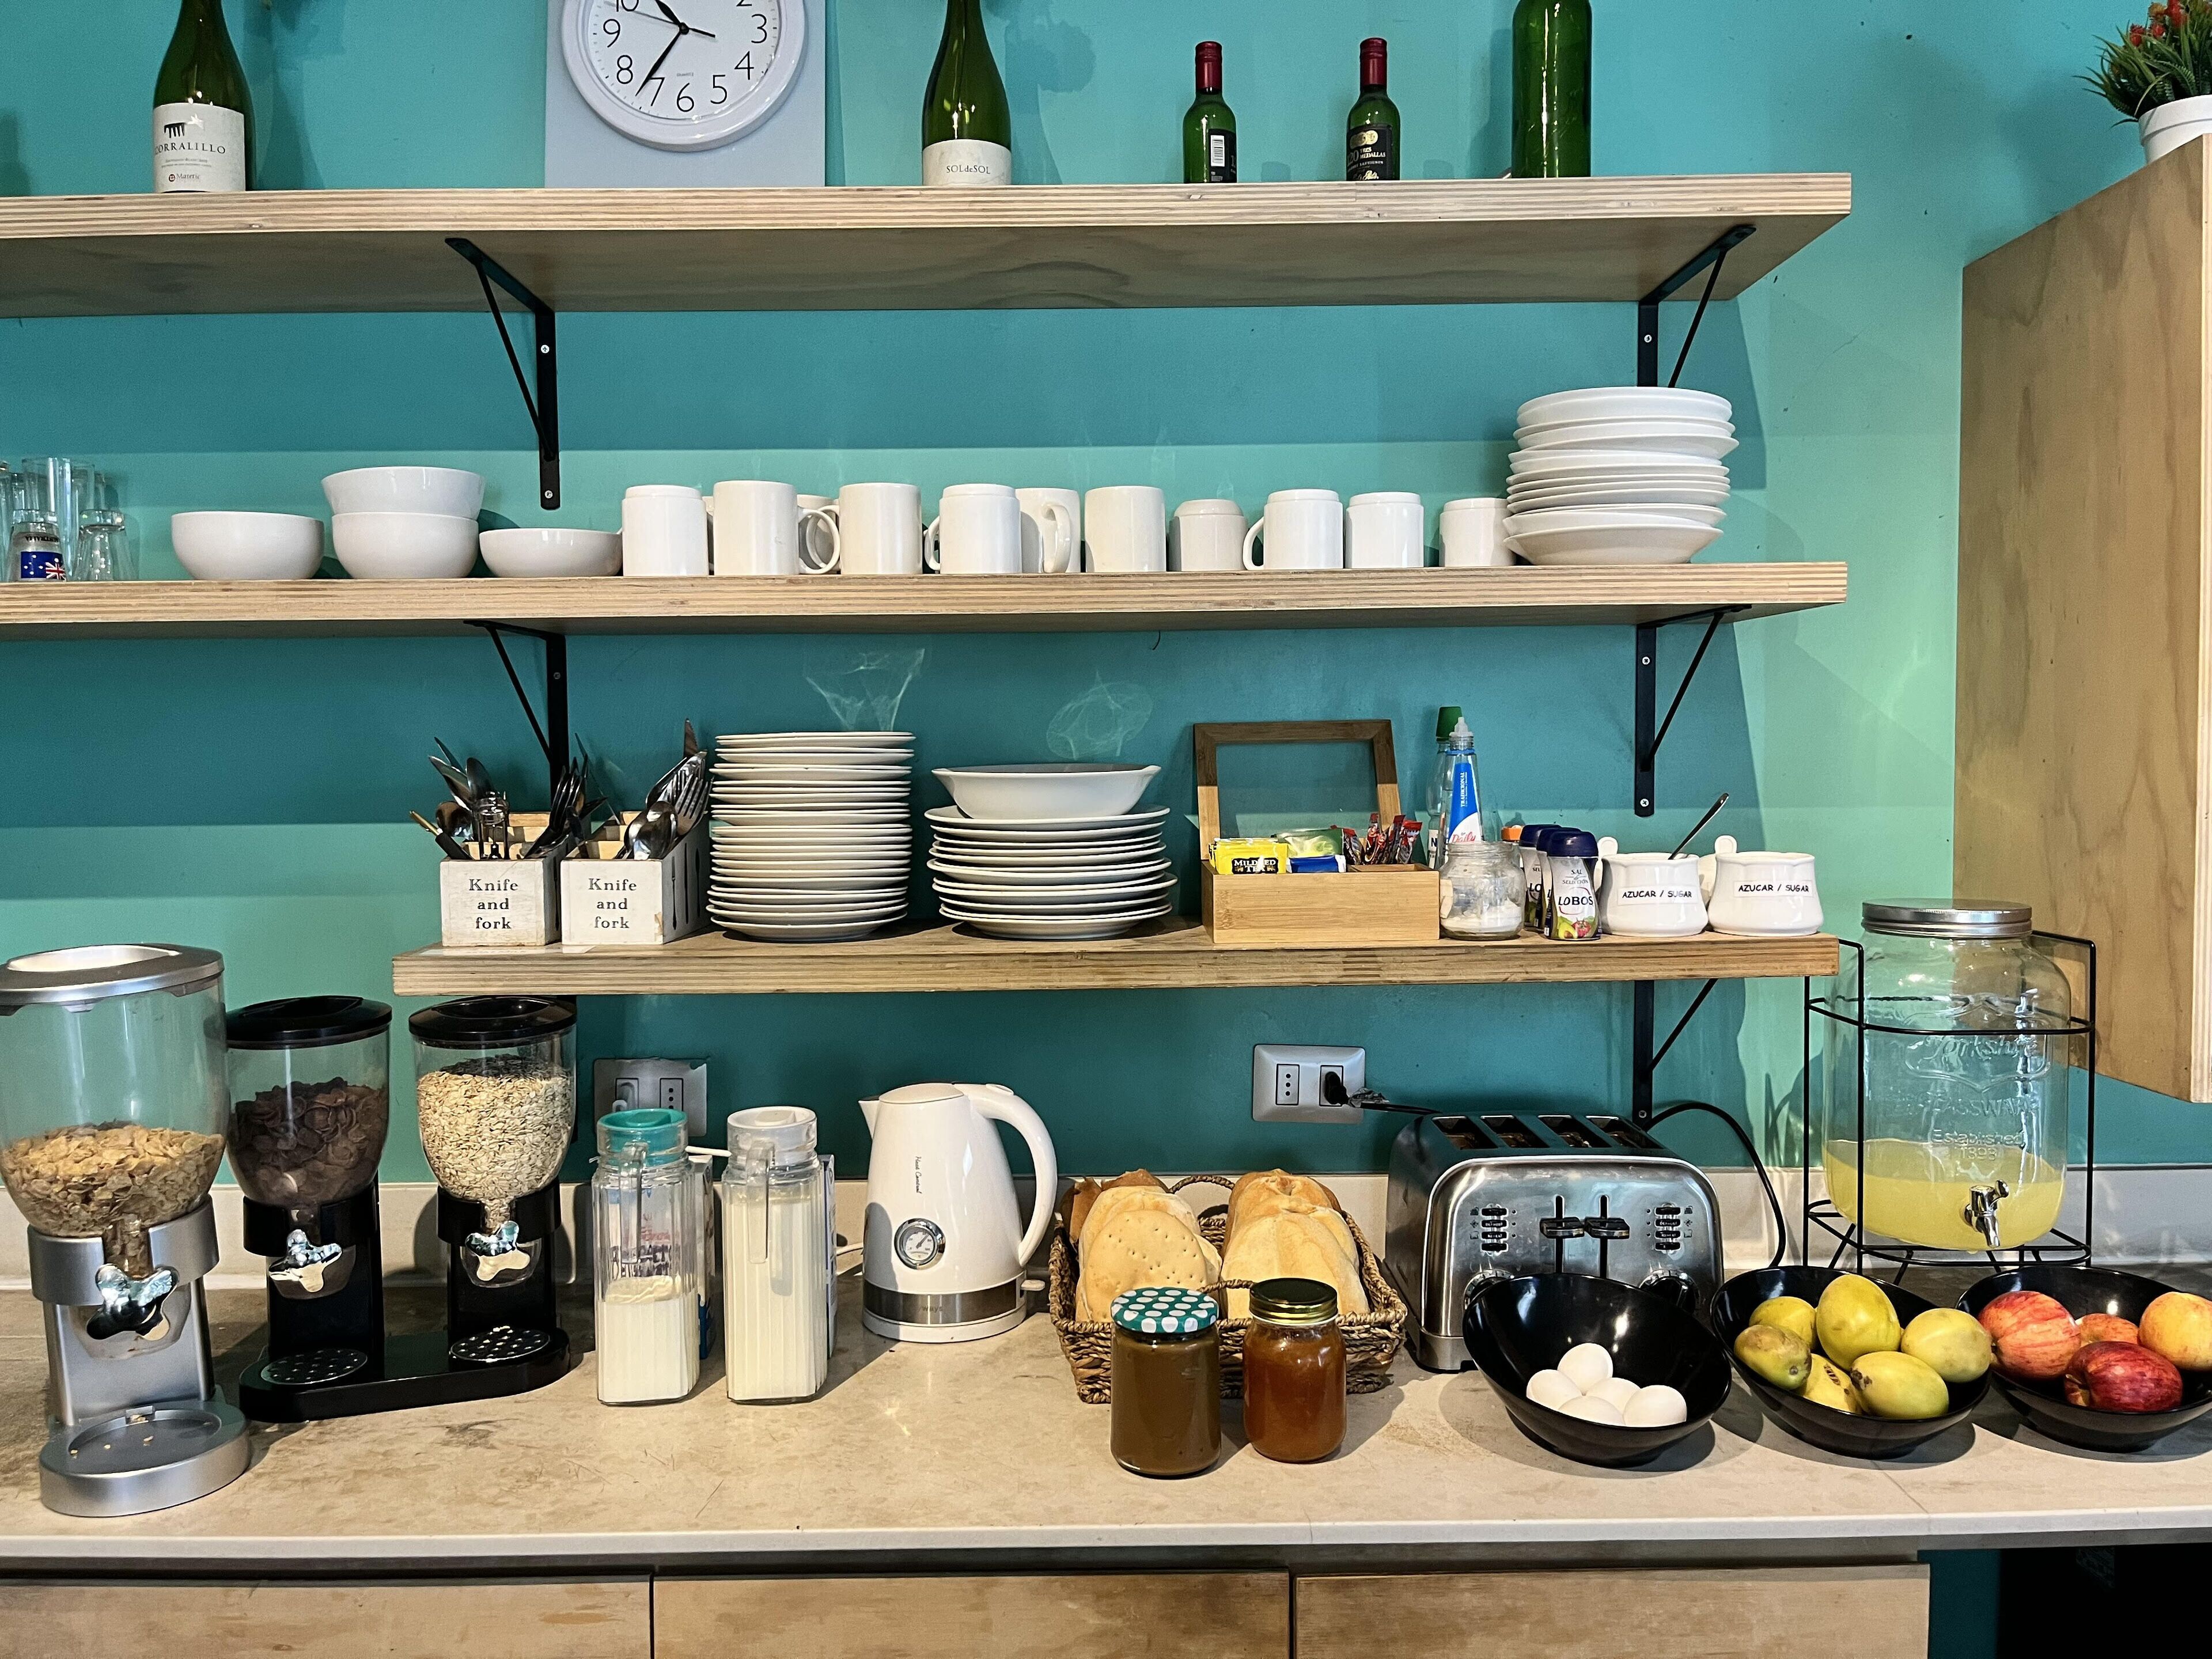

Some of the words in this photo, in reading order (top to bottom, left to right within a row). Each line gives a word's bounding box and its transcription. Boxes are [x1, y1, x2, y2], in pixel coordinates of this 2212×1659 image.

[603, 18, 621, 48] 9
[751, 14, 767, 44] 3
[616, 55, 634, 85] 8
[734, 51, 755, 80] 4
[649, 77, 665, 107] 7
[710, 74, 728, 104] 5
[676, 82, 695, 112] 6
[155, 142, 226, 155] CORRALILLO
[469, 878, 519, 892] Knife
[588, 878, 637, 891] Knife
[1738, 884, 1774, 892] AZUCAR
[1785, 884, 1809, 893] SUGAR
[1558, 896, 1593, 906] LOBOS
[1622, 891, 1656, 899] AZUCAR
[1667, 890, 1692, 899] SUGAR
[477, 898, 510, 910] and
[596, 898, 628, 910] and
[475, 917, 512, 930] fork
[594, 916, 630, 929] fork
